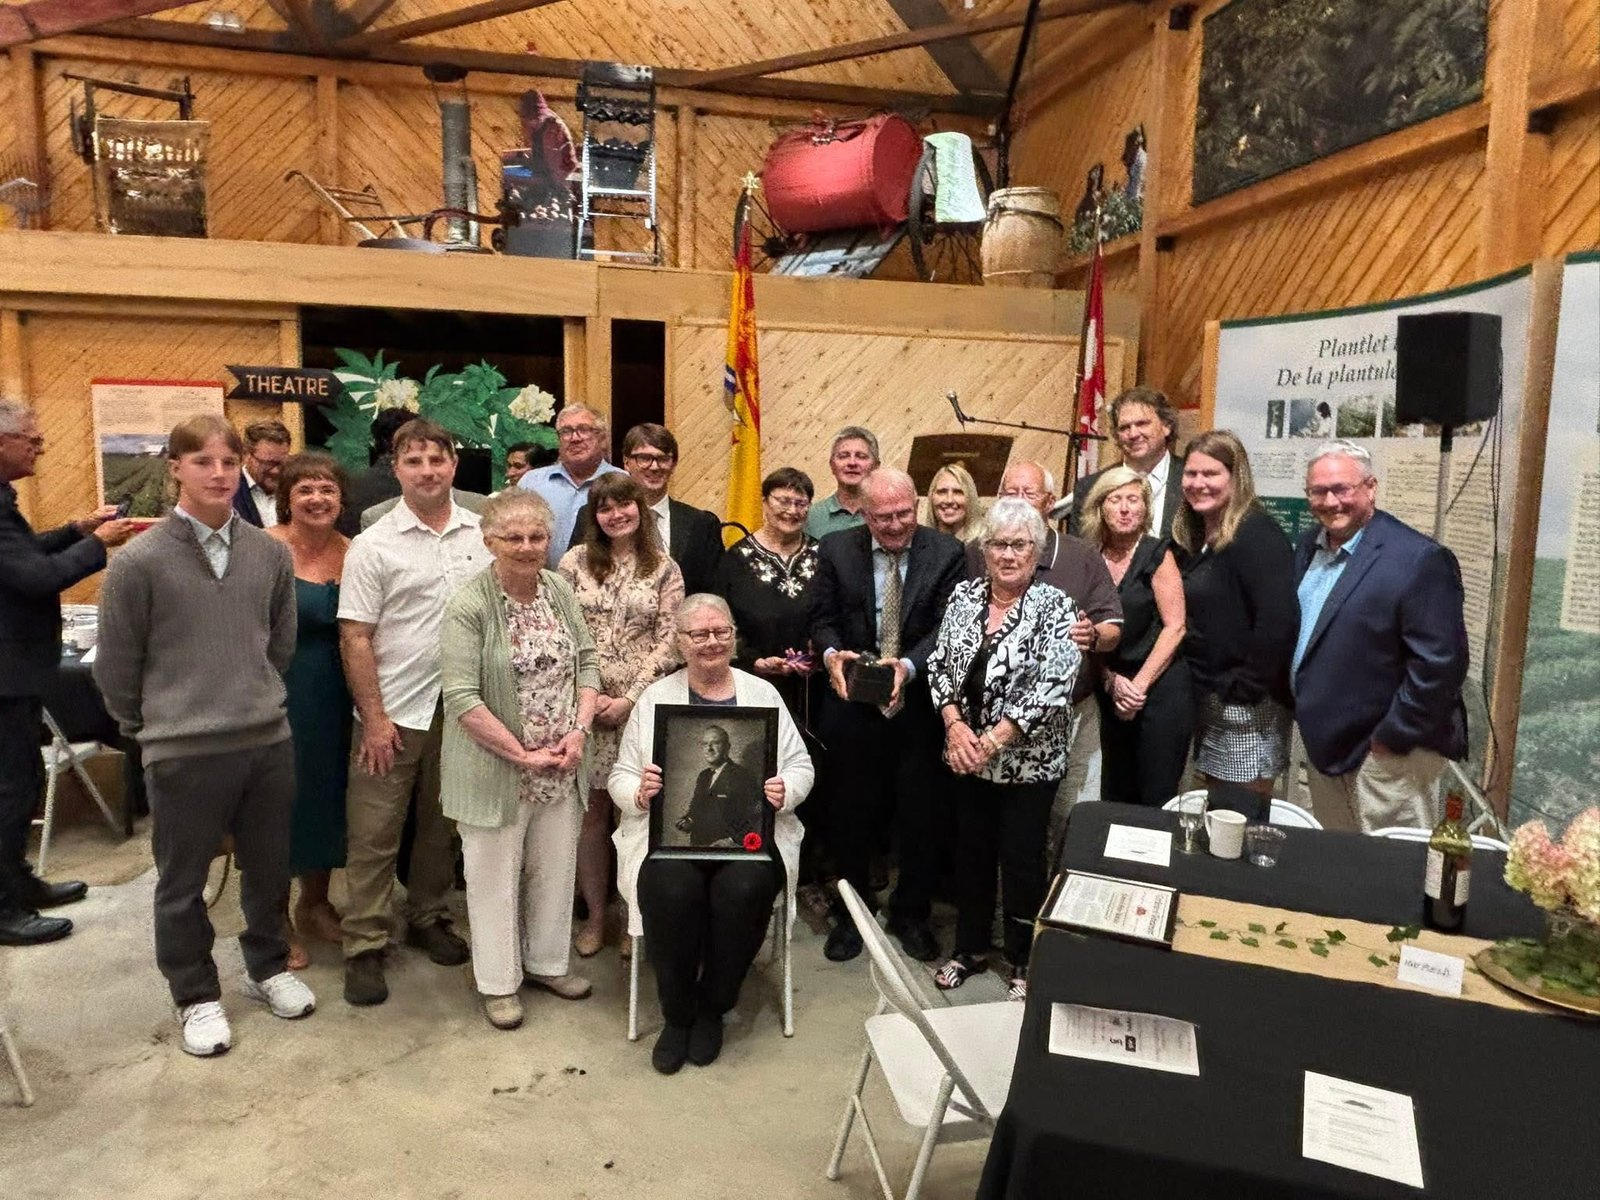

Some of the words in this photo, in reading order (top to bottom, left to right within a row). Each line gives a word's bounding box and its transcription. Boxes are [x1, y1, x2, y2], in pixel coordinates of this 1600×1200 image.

[1319, 333, 1389, 358] Plantlet
[245, 374, 329, 396] THEATRE
[1276, 368, 1302, 387] De
[1305, 366, 1322, 385] la
